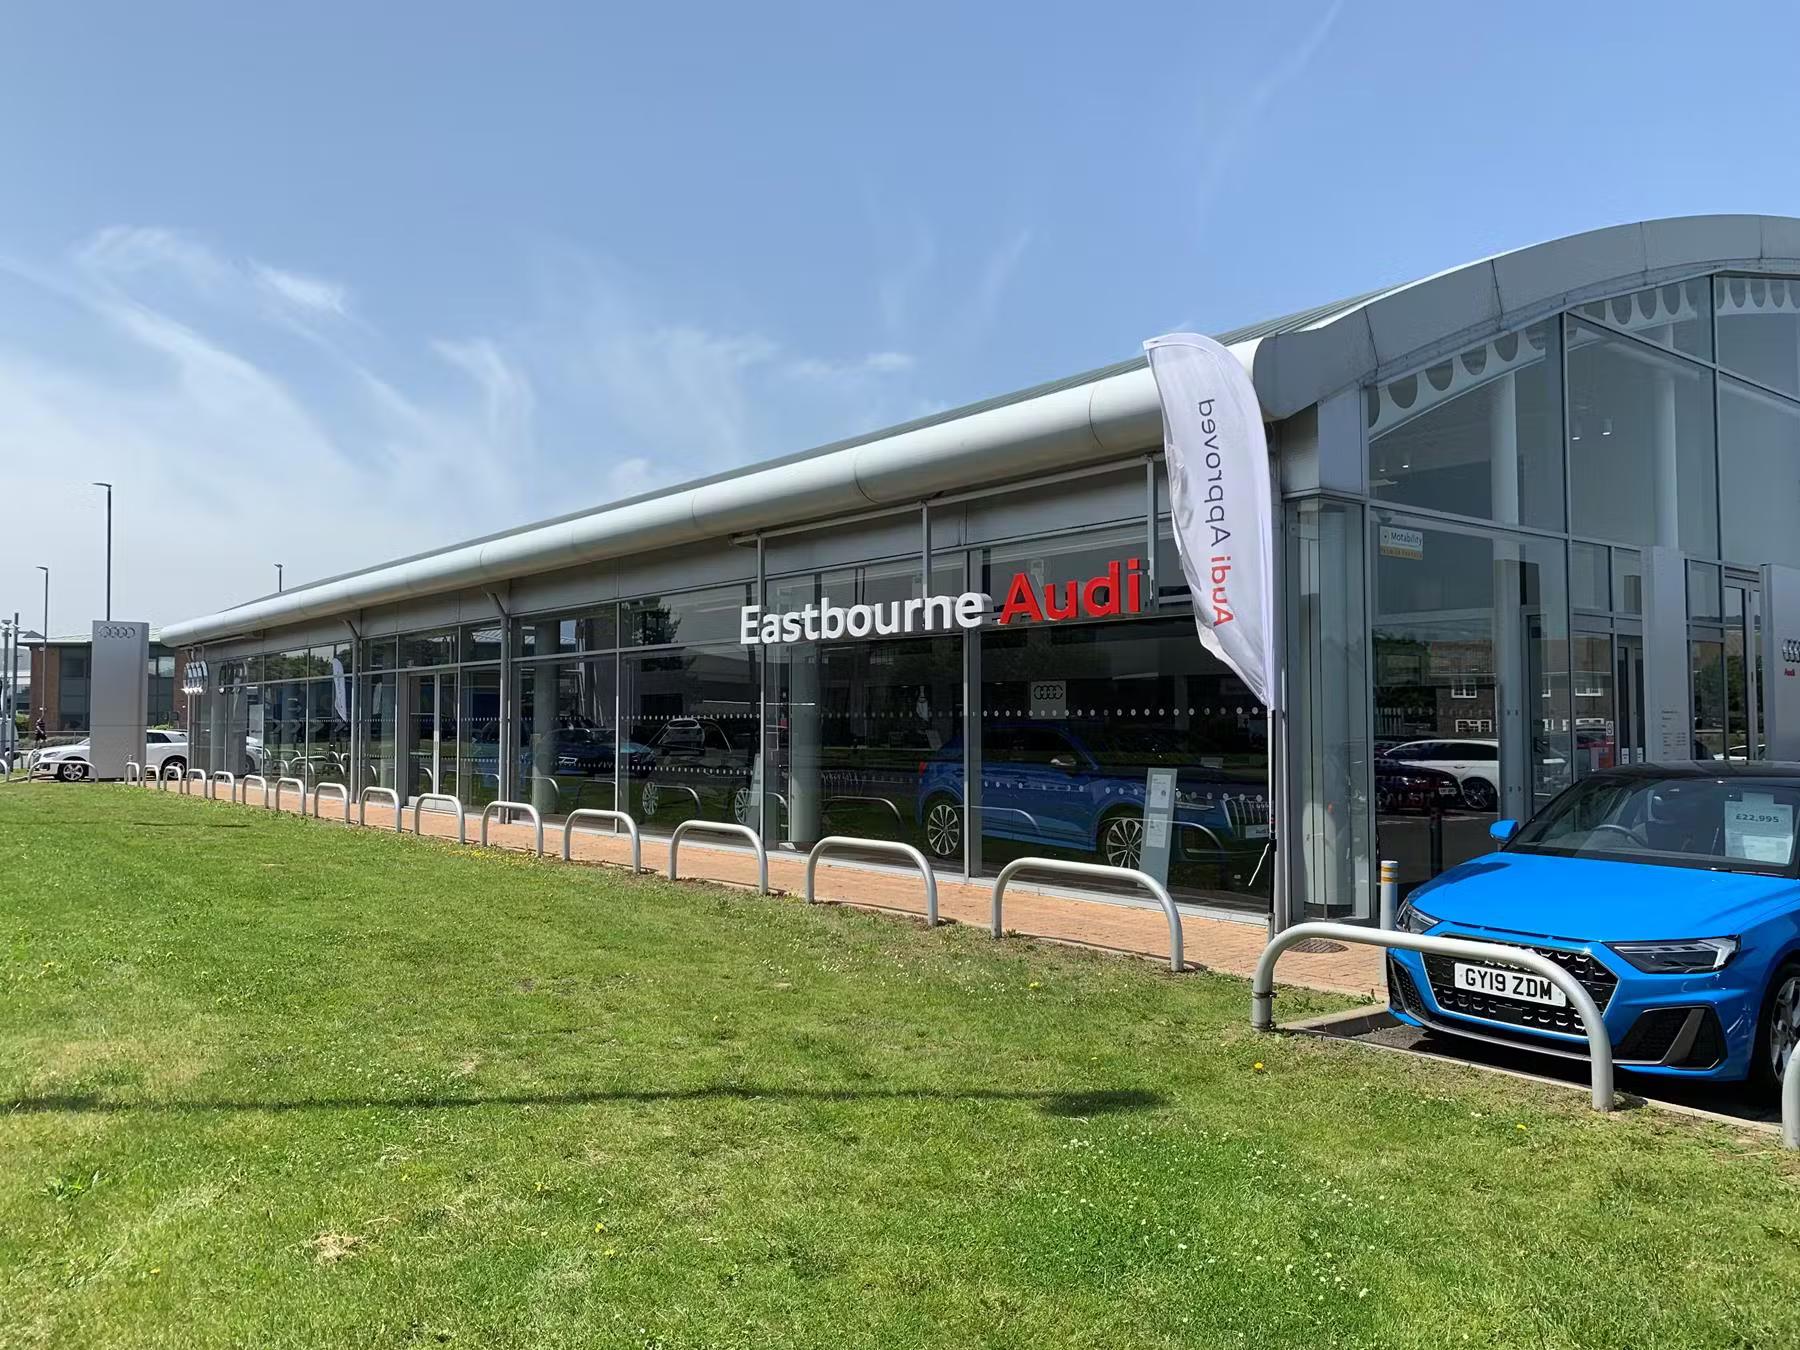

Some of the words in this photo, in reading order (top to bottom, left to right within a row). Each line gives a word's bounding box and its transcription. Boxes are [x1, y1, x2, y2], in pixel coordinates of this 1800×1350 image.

[1391, 531, 1422, 546] Motability
[740, 591, 989, 645] Eastbourne
[999, 557, 1142, 625] Audi
[1735, 813, 1780, 823] £22,995
[1465, 968, 1506, 992] GY19
[1512, 976, 1552, 1001] ZDM
